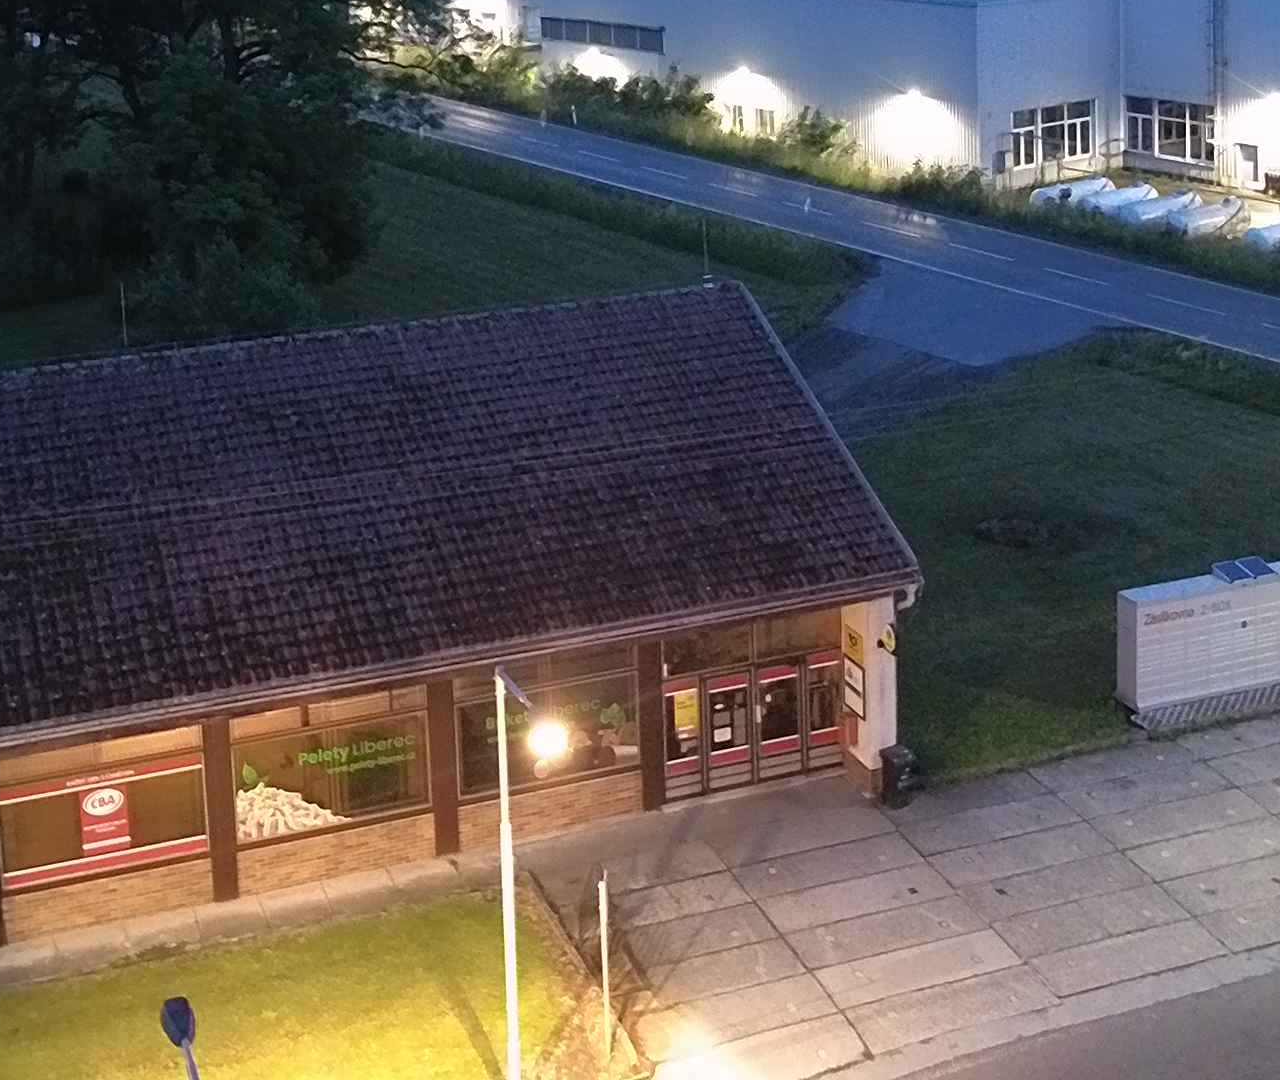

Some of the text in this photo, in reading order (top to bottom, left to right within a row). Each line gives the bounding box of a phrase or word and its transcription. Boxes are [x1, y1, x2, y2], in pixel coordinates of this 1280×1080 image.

[298, 734, 416, 766] Pelety Liberec
[90, 794, 116, 810] CBA
